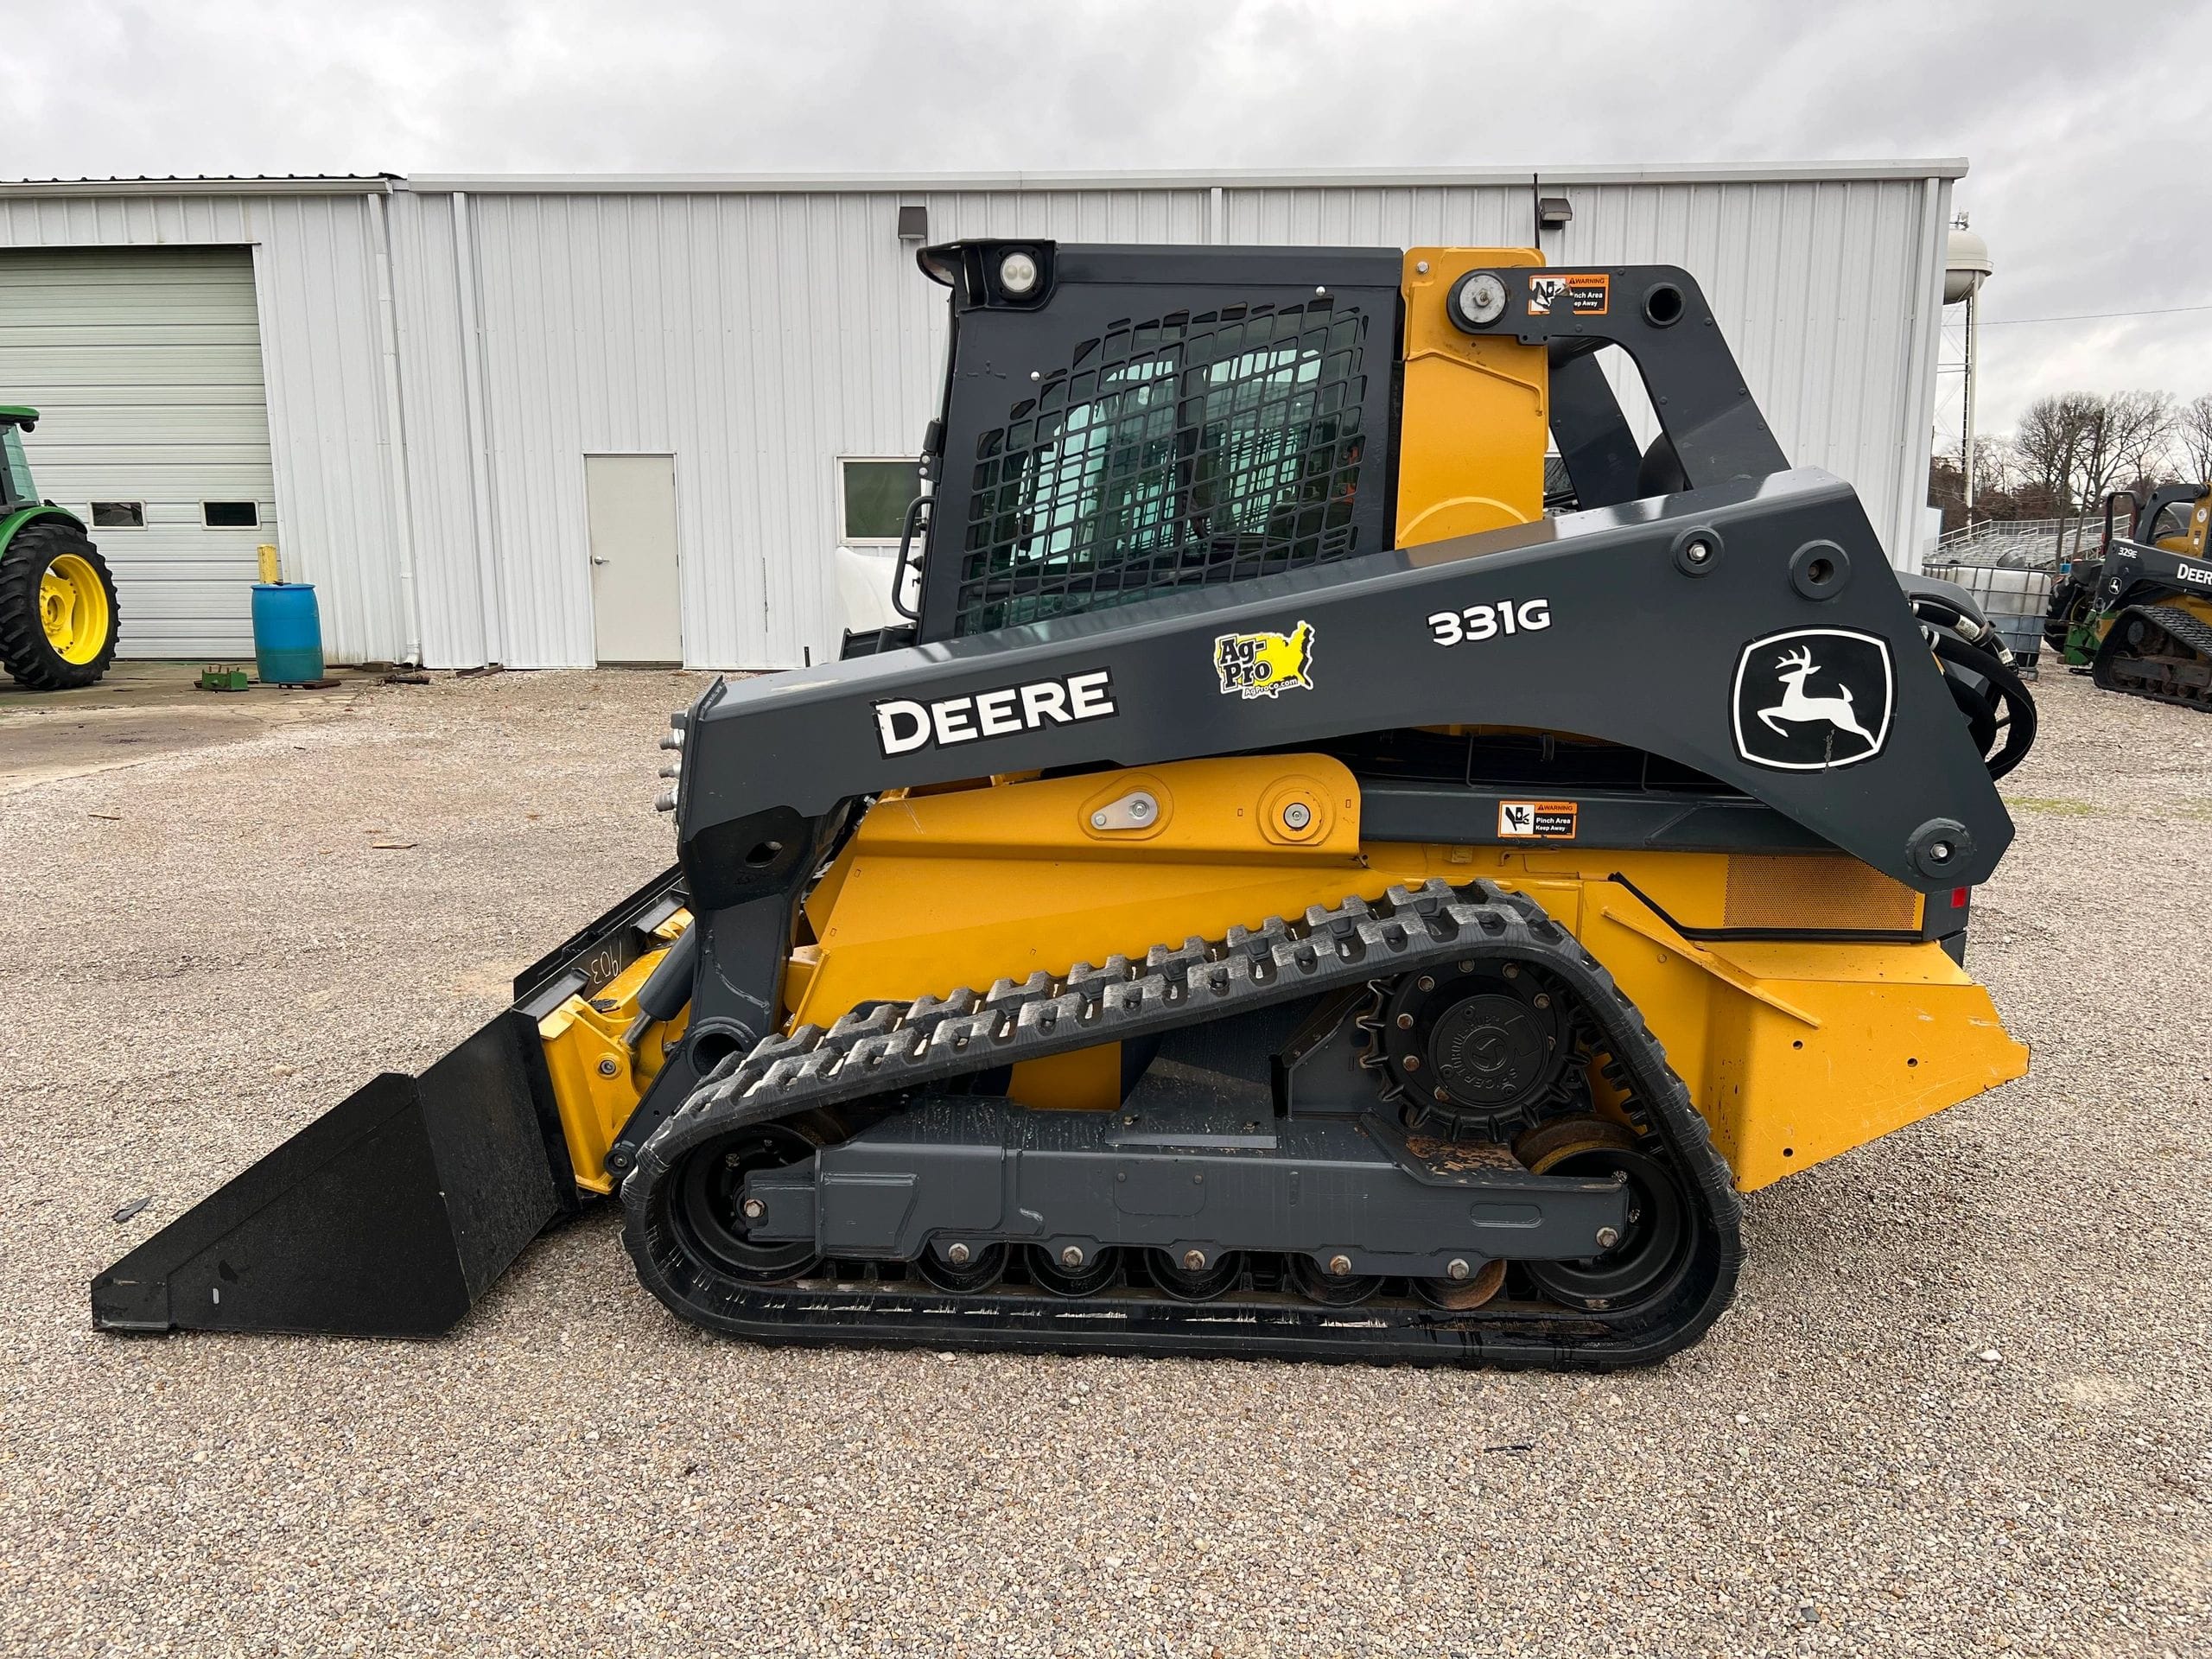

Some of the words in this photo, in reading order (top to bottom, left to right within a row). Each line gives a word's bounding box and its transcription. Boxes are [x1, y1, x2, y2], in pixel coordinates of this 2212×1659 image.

[2118, 546, 2138, 559] 329E
[1427, 599, 1551, 646] 331G
[1220, 639, 1265, 664] Ag-
[1224, 662, 1270, 688] Pro
[1244, 678, 1298, 696] AgProCo.com
[875, 671, 1115, 754] DEERE
